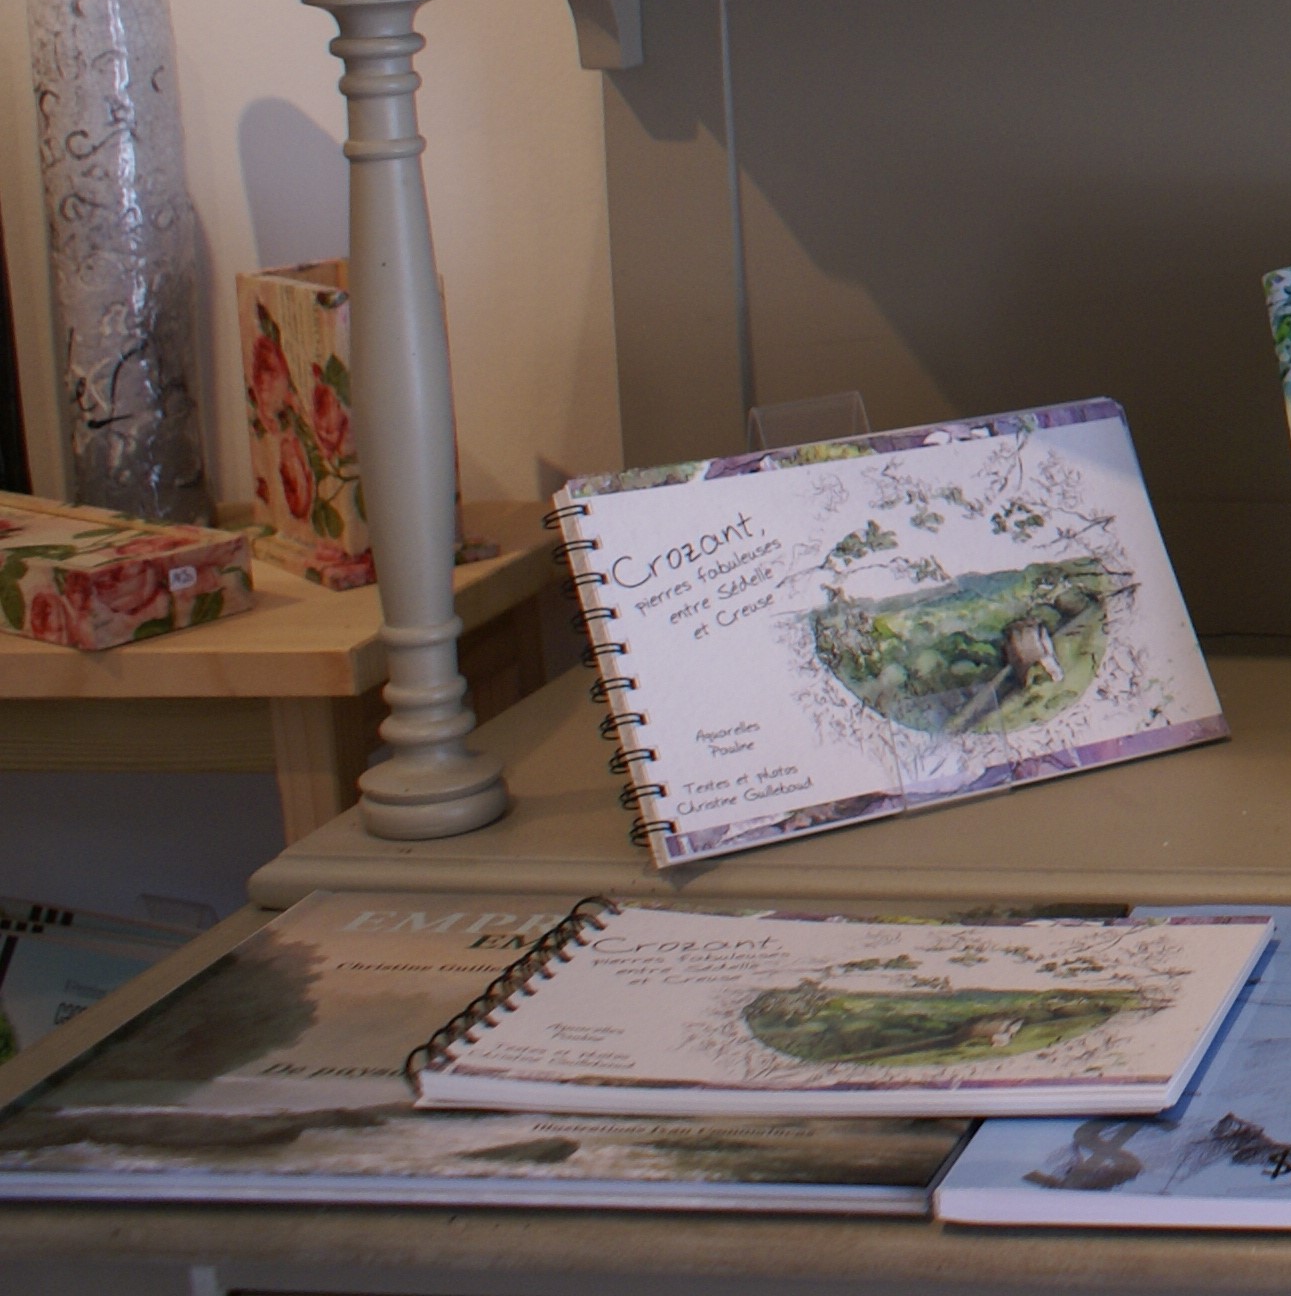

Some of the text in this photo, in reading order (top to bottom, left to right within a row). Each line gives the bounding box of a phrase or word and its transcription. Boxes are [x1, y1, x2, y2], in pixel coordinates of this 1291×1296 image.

[612, 512, 766, 588] Crozant,
[634, 538, 782, 617] pierres fabuleuses
[669, 597, 712, 625] entre
[693, 593, 775, 640] et Creuse
